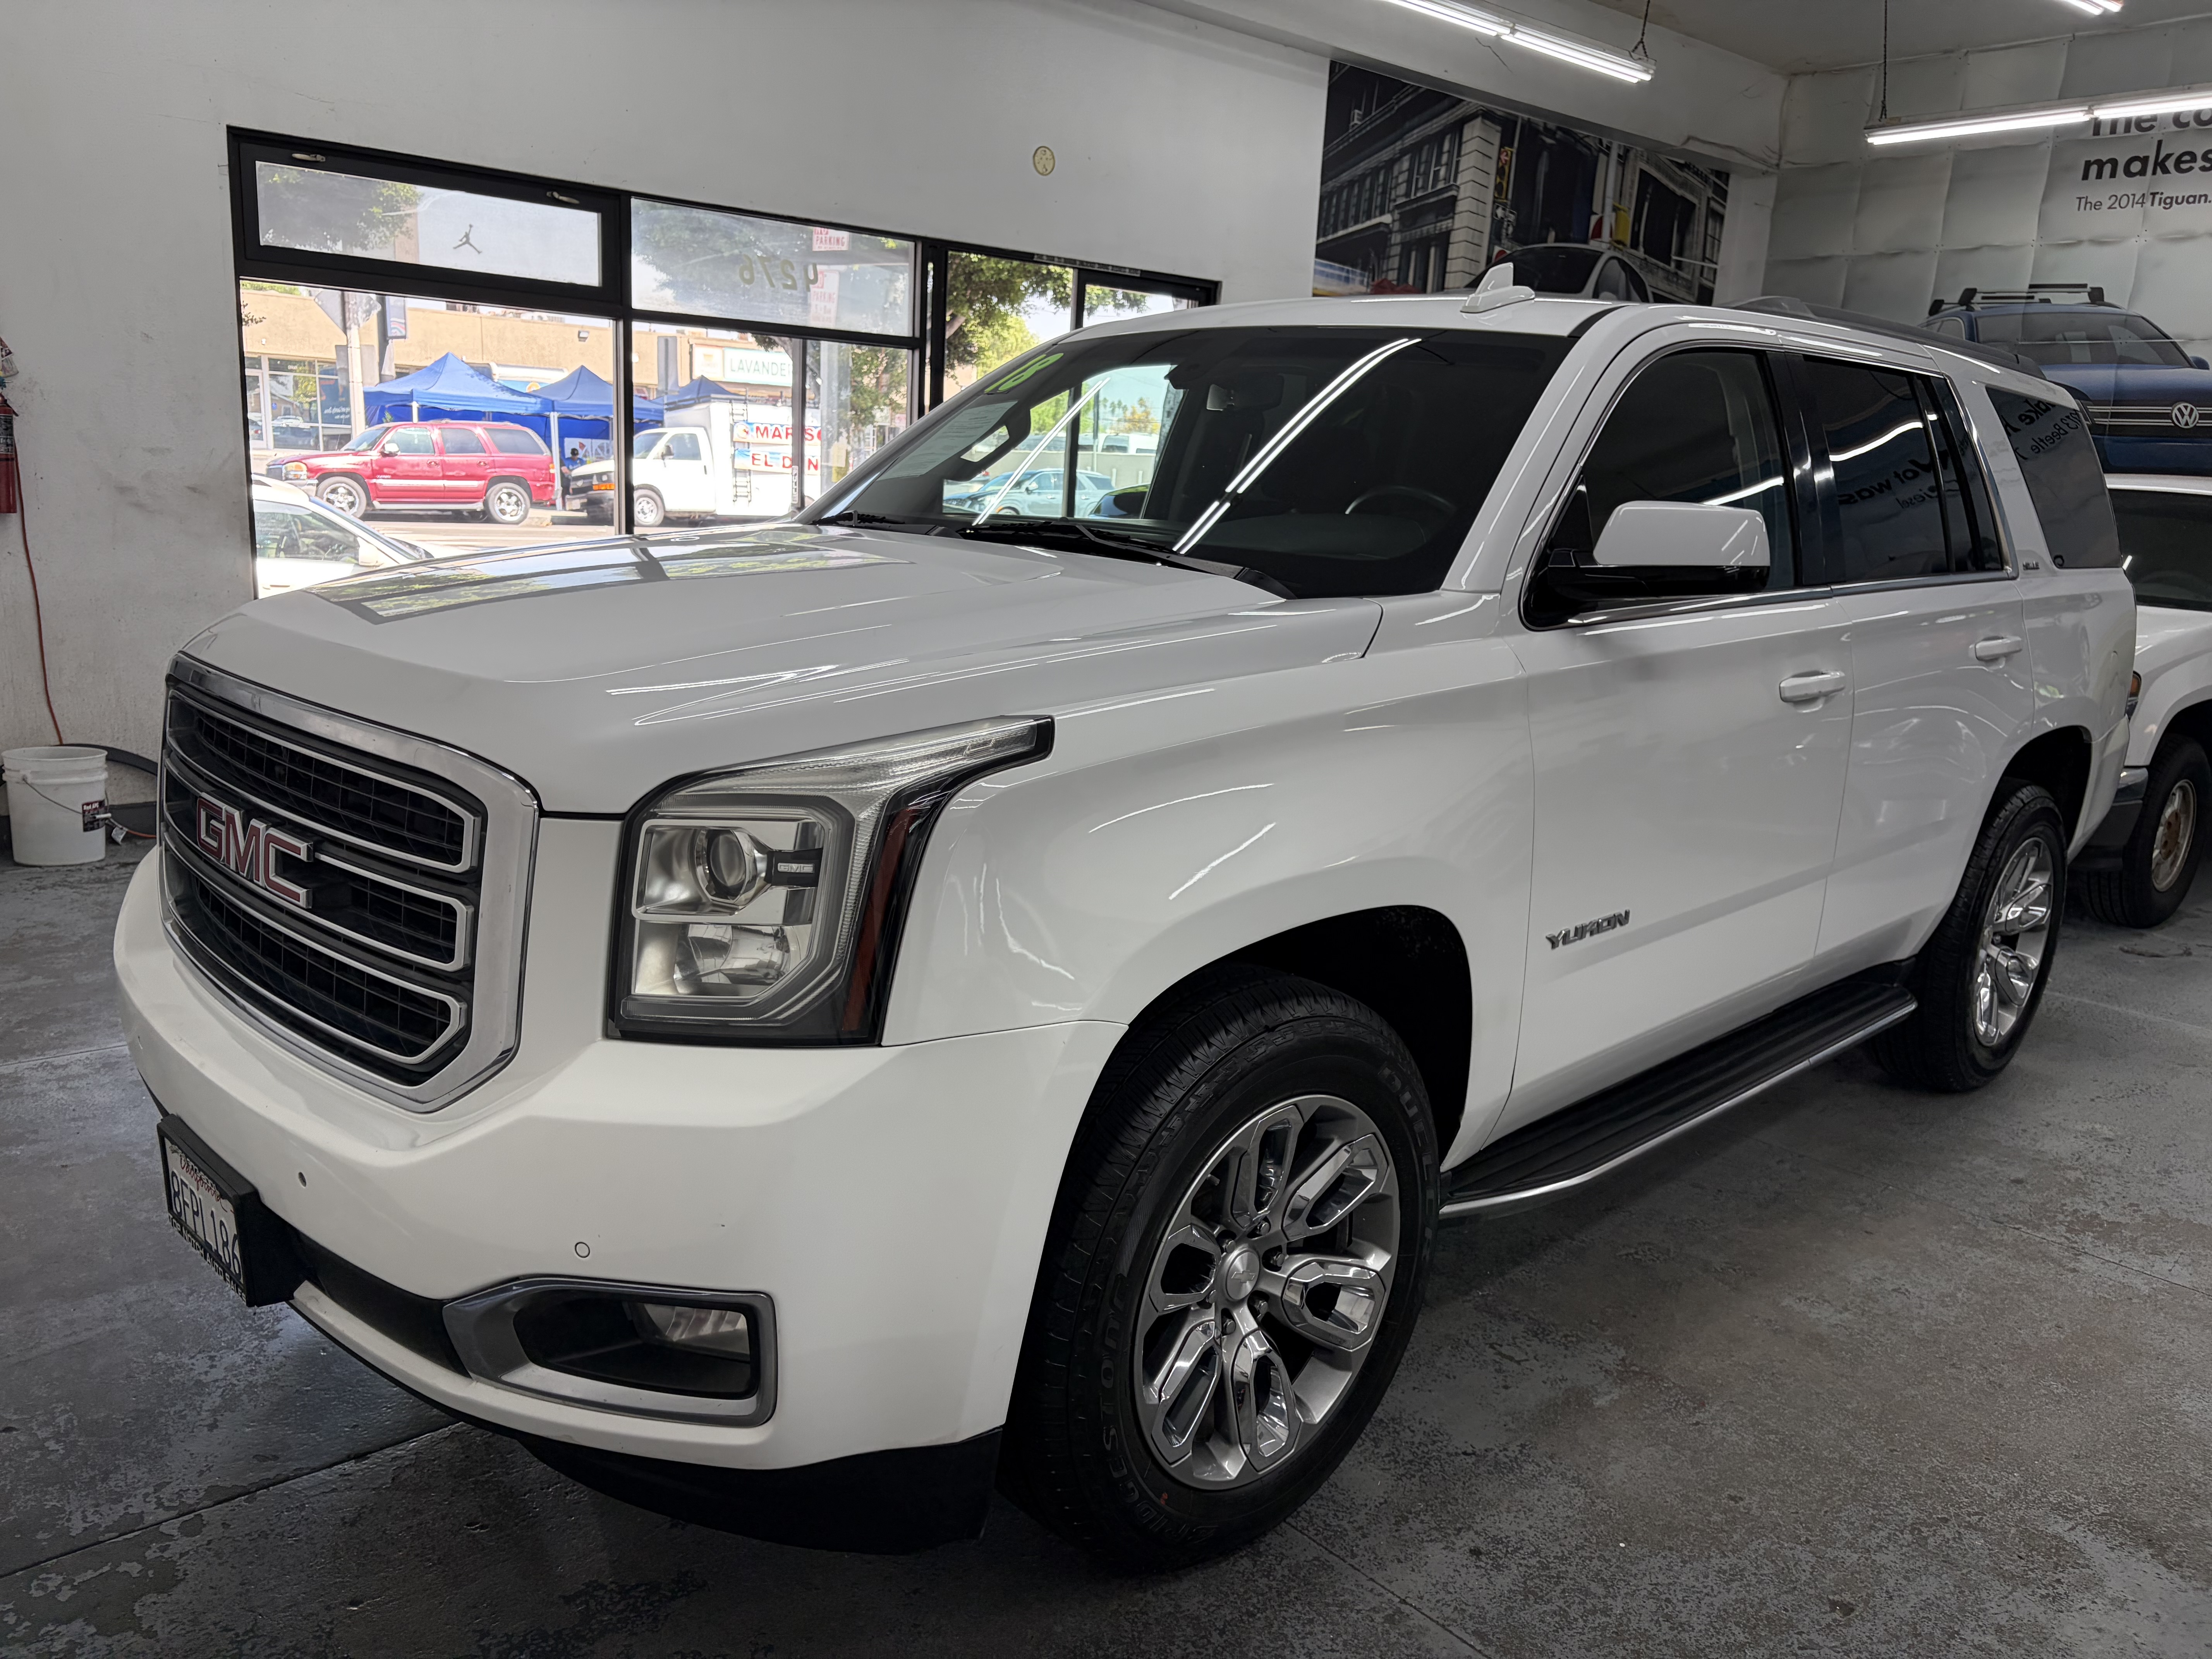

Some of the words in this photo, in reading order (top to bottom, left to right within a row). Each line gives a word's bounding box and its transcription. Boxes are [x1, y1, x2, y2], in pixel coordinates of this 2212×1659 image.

[2092, 114, 2159, 136] he
[2081, 139, 2212, 181] makes
[2076, 195, 2103, 211] The
[2107, 193, 2146, 210] 2014
[2149, 191, 2212, 210] Tiguan.
[816, 236, 845, 247] PARKING
[984, 352, 1064, 393] 18
[752, 453, 773, 467] EL
[197, 792, 313, 908] GMC
[778, 863, 814, 873] GMC
[1546, 909, 1630, 951] YUKON
[171, 1170, 242, 1283] 8FPL186
[168, 1213, 181, 1235] TOP
[182, 1226, 205, 1260] NOTCH
[206, 1252, 224, 1279] AUTO
[225, 1273, 247, 1305] SALES
